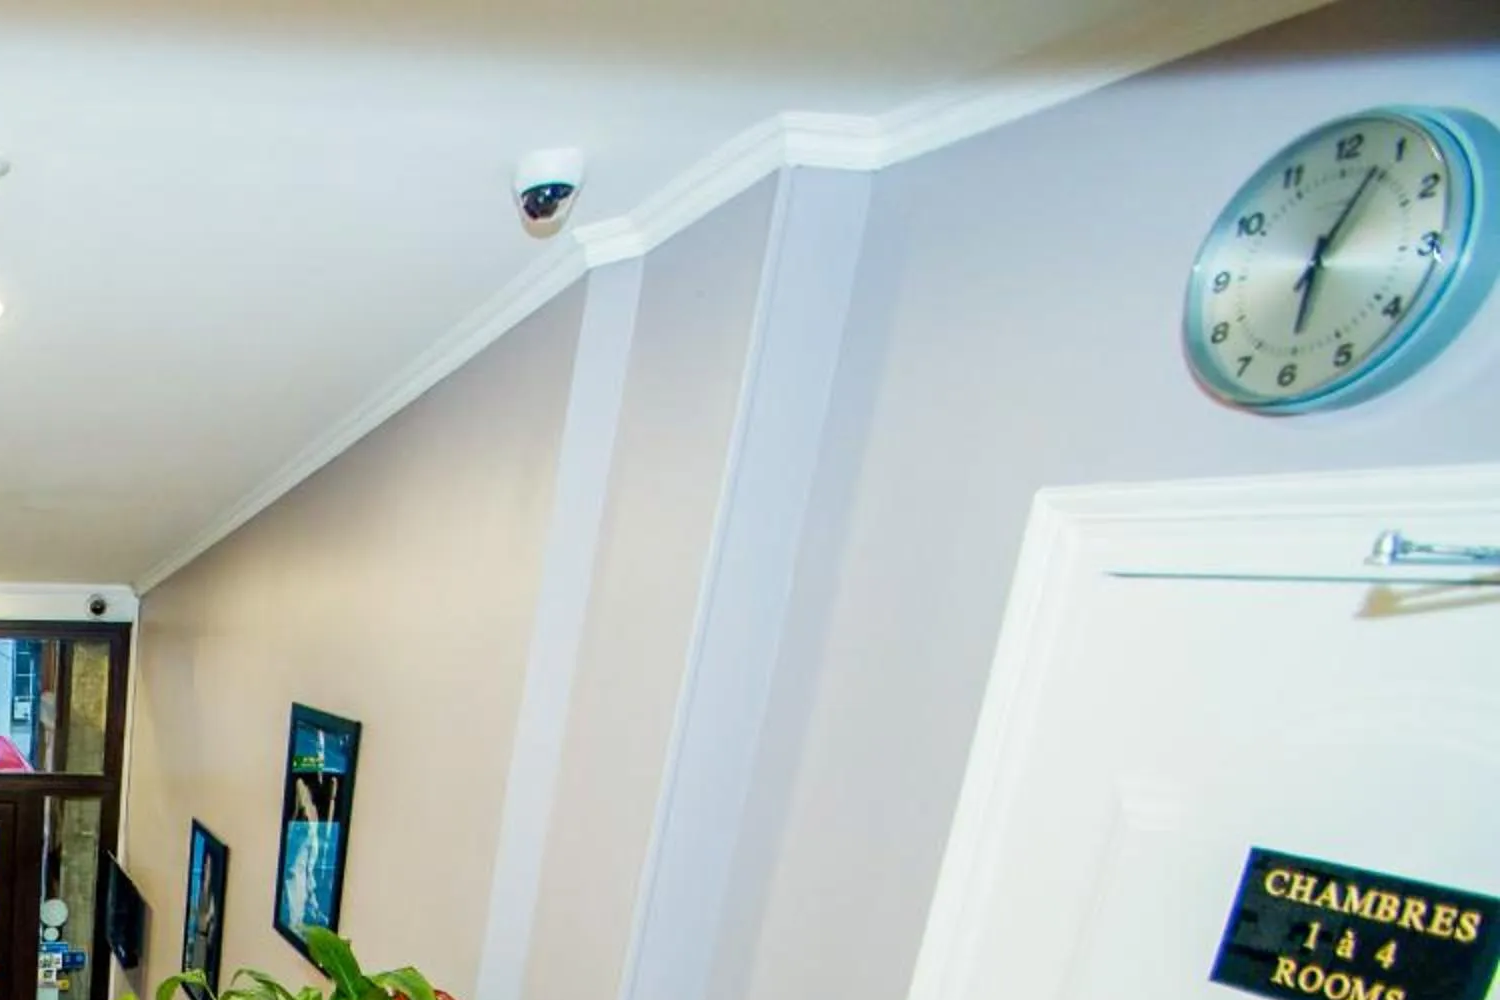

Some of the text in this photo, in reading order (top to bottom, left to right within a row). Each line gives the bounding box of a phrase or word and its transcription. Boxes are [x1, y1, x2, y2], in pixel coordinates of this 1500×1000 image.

[1335, 133, 1364, 160] 12
[1395, 138, 1407, 162] 1
[1283, 165, 1305, 189] 11
[1418, 173, 1441, 199] 2
[1235, 212, 1265, 238] 10
[1417, 231, 1442, 257] 3
[1211, 271, 1231, 294] 9
[1381, 295, 1402, 320] 4
[1210, 322, 1230, 344] 8
[1235, 355, 1252, 378] 7
[1333, 343, 1354, 367] 5
[1277, 364, 1297, 387] 6
[1264, 869, 1482, 943] CHAMBRES
[1303, 921, 1397, 970] 1 à 4
